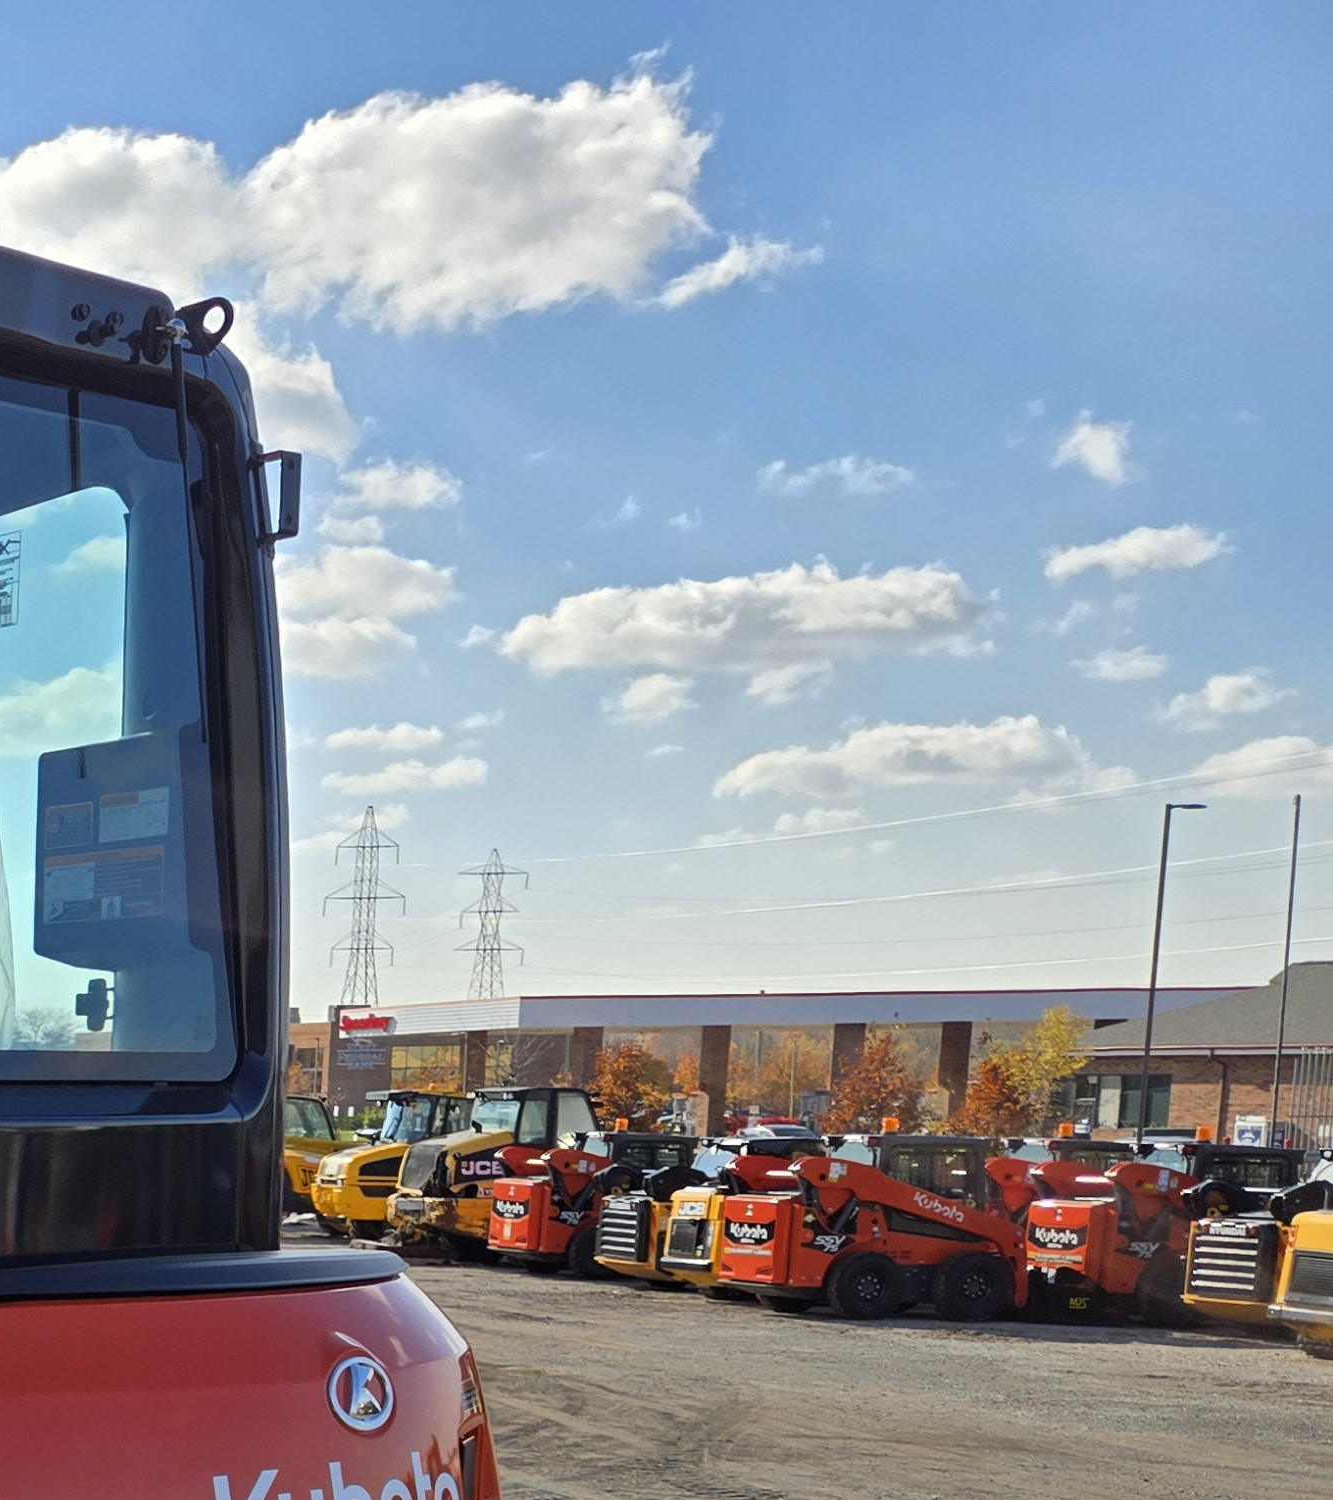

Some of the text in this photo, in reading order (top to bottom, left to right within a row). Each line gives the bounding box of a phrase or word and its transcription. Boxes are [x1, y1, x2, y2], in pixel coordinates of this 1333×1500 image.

[300, 1168, 317, 1187] JC
[496, 1200, 525, 1215] Kubota
[913, 1191, 965, 1223] Kubota
[730, 1222, 769, 1240] Kubota
[1035, 1227, 1079, 1245] Kubota
[813, 1235, 847, 1246] SSV
[1128, 1242, 1161, 1251] SSV
